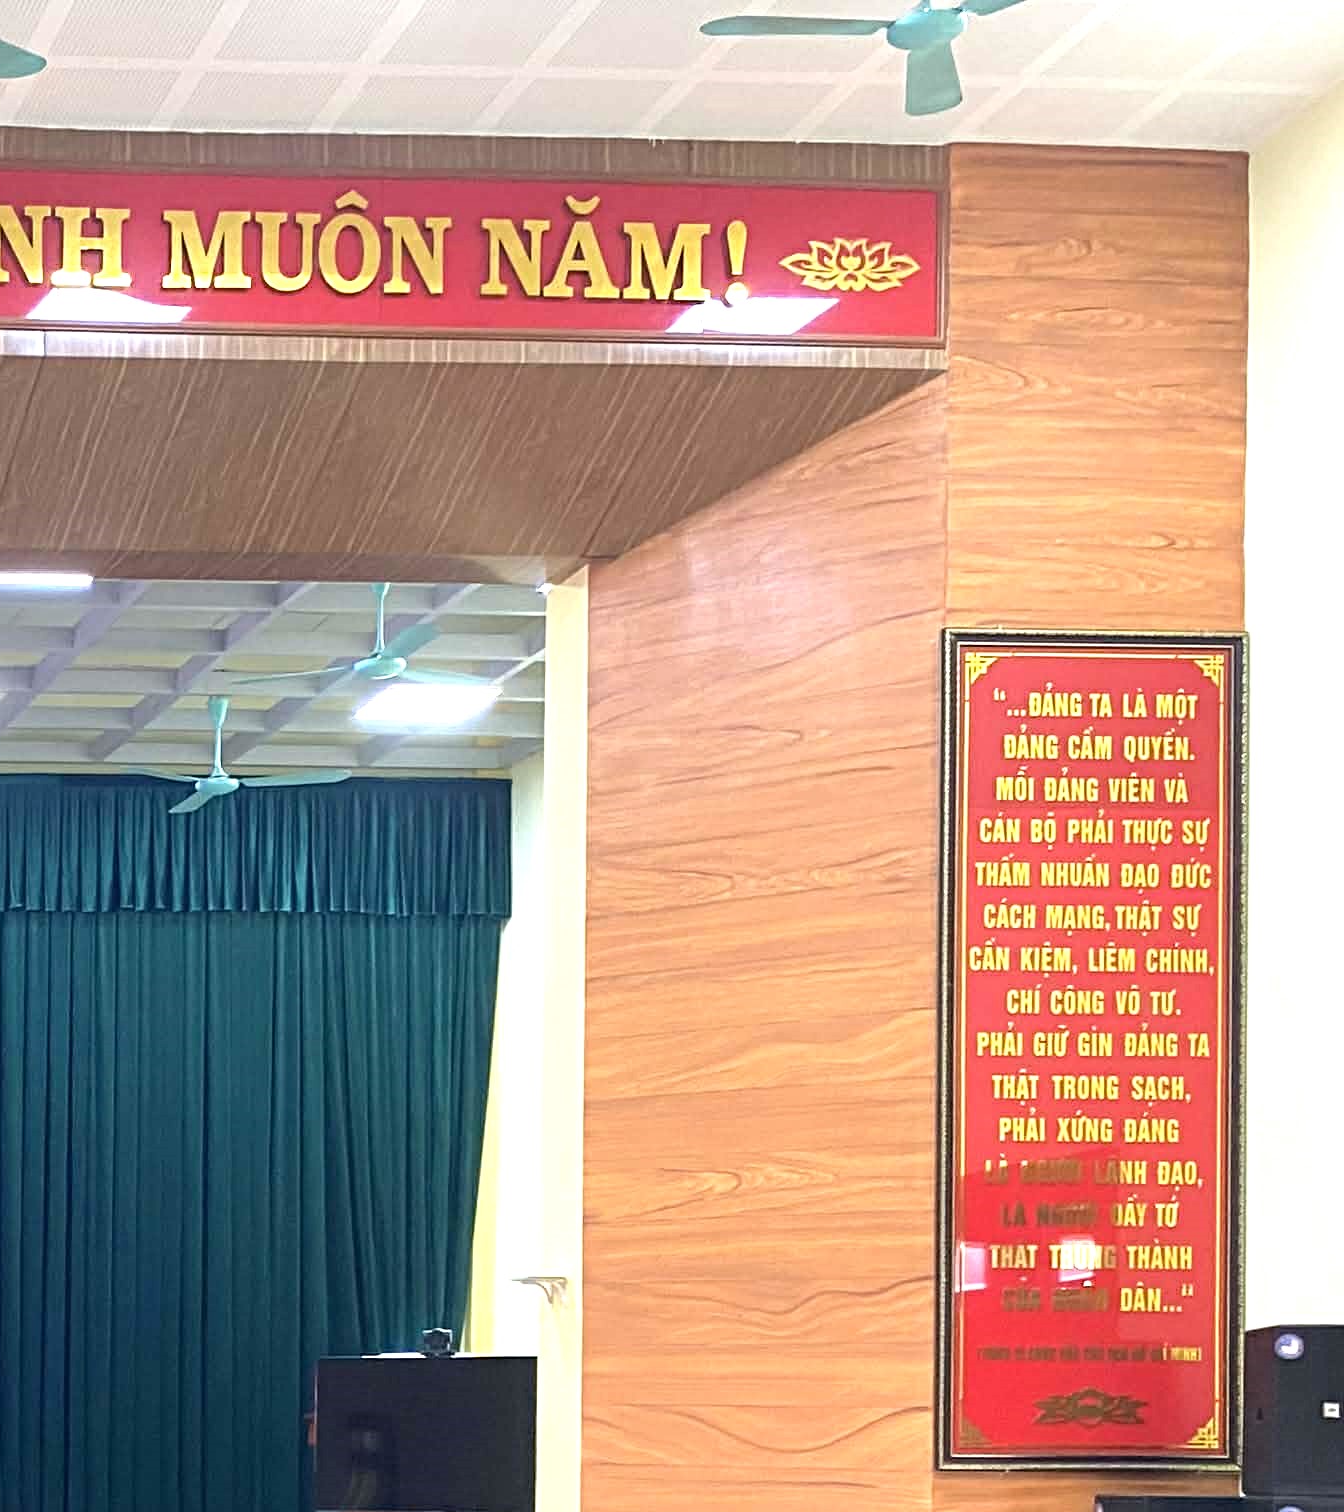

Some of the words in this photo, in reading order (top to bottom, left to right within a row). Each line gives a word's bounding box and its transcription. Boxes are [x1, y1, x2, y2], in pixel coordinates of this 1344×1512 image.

[162, 191, 452, 294] MUÔN
[480, 195, 750, 307] NĂM!
[1090, 694, 1112, 718] TA
[1123, 688, 1147, 718] LÀ
[1156, 688, 1198, 725] MỘT
[1003, 724, 1058, 759] ĐẢNG
[1044, 767, 1098, 801] ĐẢNG
[1108, 772, 1154, 802] VIÊN
[1165, 773, 1189, 803] VÀ
[979, 813, 1020, 843] CÁN
[1030, 811, 1056, 849] BỘ
[1068, 809, 1112, 844] PHẢI
[1123, 819, 1172, 851] THỰC
[1182, 819, 1211, 852] SỰ
[1120, 863, 1159, 894] ĐẠO
[1171, 858, 1212, 888] ĐỨC
[983, 898, 1035, 929] CÁCH
[1045, 905, 1111, 936] MẠNG,
[1115, 900, 1162, 936] THẬT
[1172, 904, 1202, 937] SỰ
[1020, 941, 1078, 977] KIỆM,
[1088, 943, 1135, 973] LIÊM
[1146, 942, 1215, 976] CHÍNH,
[1006, 984, 1042, 1014] CHÍ
[1050, 985, 1105, 1015] CÔNG
[1115, 985, 1140, 1015] VÔ
[1151, 990, 1181, 1016] TƯ.
[977, 1021, 1023, 1056] PHẢI
[1033, 1025, 1070, 1057] GIỮ
[1078, 1026, 1112, 1057] GÌN
[1124, 1022, 1178, 1057] ĐẢNG
[1189, 1033, 1210, 1058] TA
[992, 1069, 1040, 1105] THẬT
[1053, 1076, 1119, 1100] TRONG
[1131, 1076, 1192, 1108] SẠCH,
[999, 1106, 1045, 1142] PHẢI
[1057, 1110, 1112, 1143] XỨNG
[1124, 1112, 1179, 1143] ĐÁNG
[1157, 1161, 1203, 1191] ĐẠO,
[1155, 1196, 1180, 1228] TỚ
[990, 1245, 1038, 1270] THẬT
[1050, 1245, 1116, 1270] TRUNG
[1127, 1238, 1193, 1270] THÀNH
